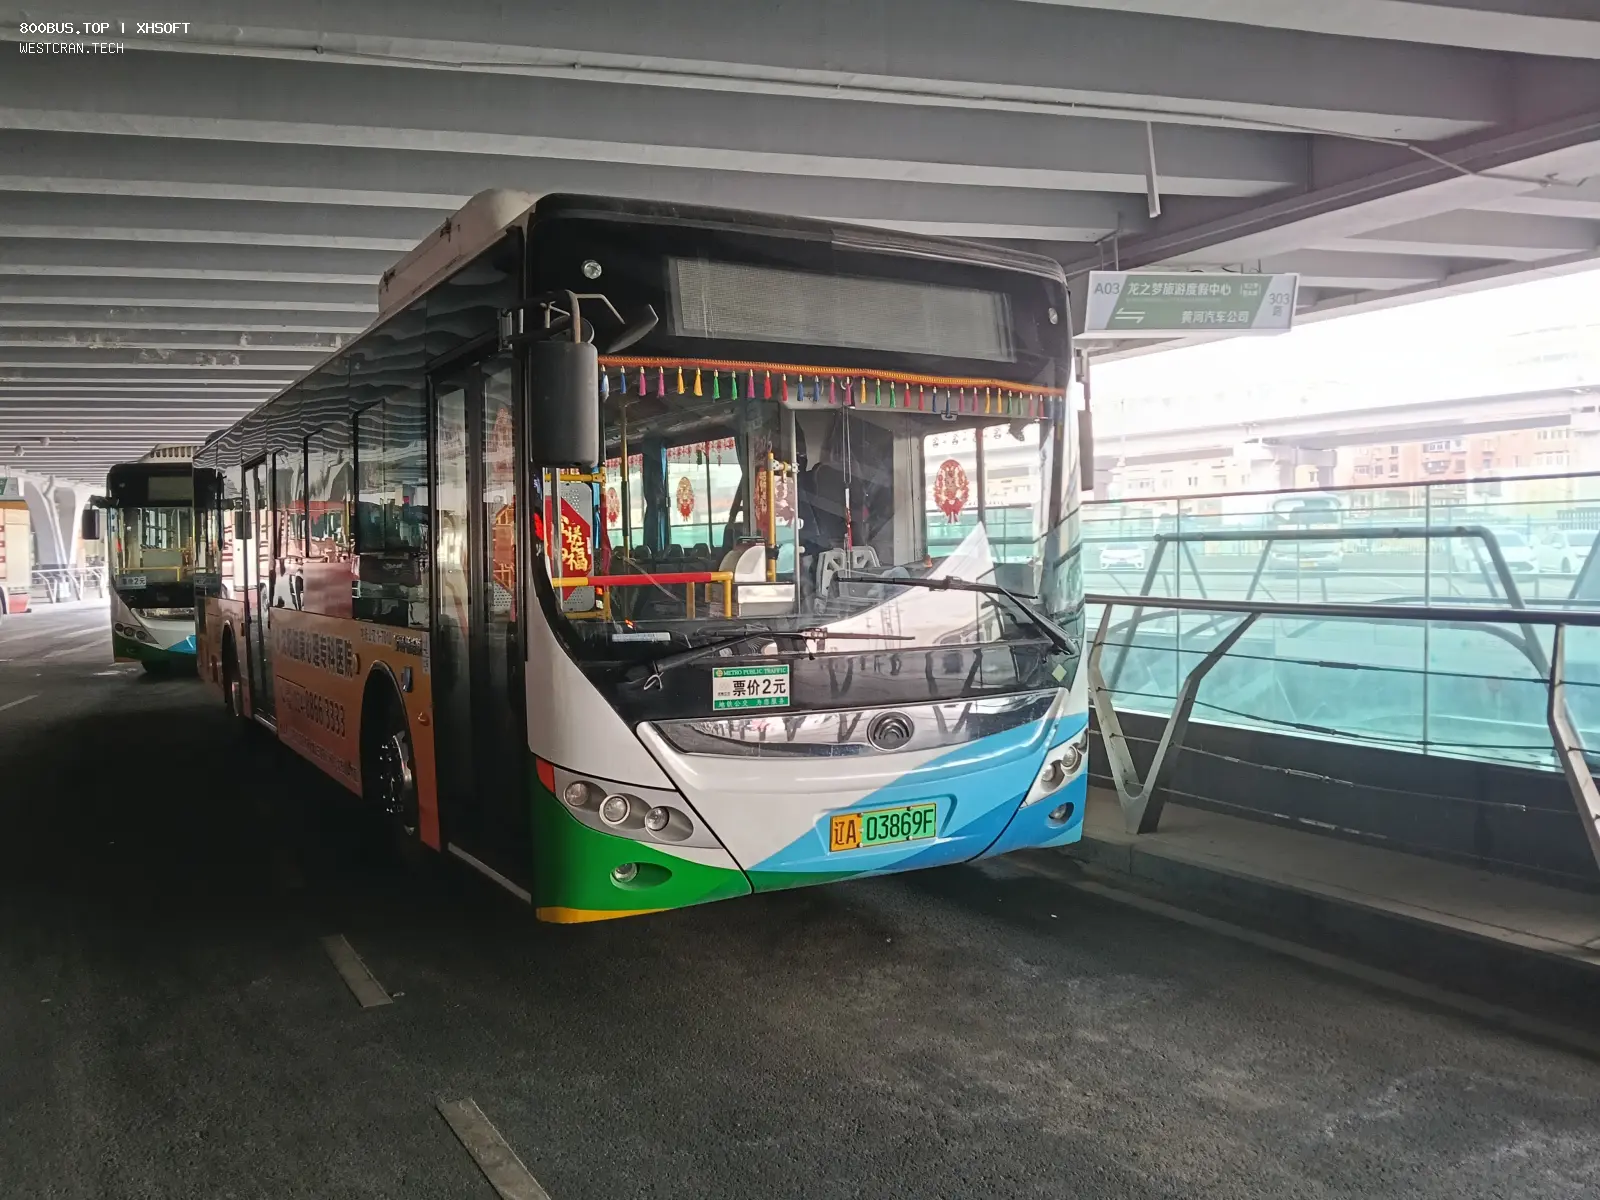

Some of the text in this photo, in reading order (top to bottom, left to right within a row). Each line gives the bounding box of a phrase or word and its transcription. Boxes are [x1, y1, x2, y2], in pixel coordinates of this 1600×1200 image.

[1094, 282, 1121, 295] A03
[1127, 282, 1232, 297] 龙之梦旅游度假中心
[1268, 293, 1291, 305] 303
[1181, 310, 1249, 324] 黄河汽车公司
[732, 678, 787, 697] 票价2元
[718, 699, 749, 708] 地铁公交
[866, 808, 935, 841] 03869F
